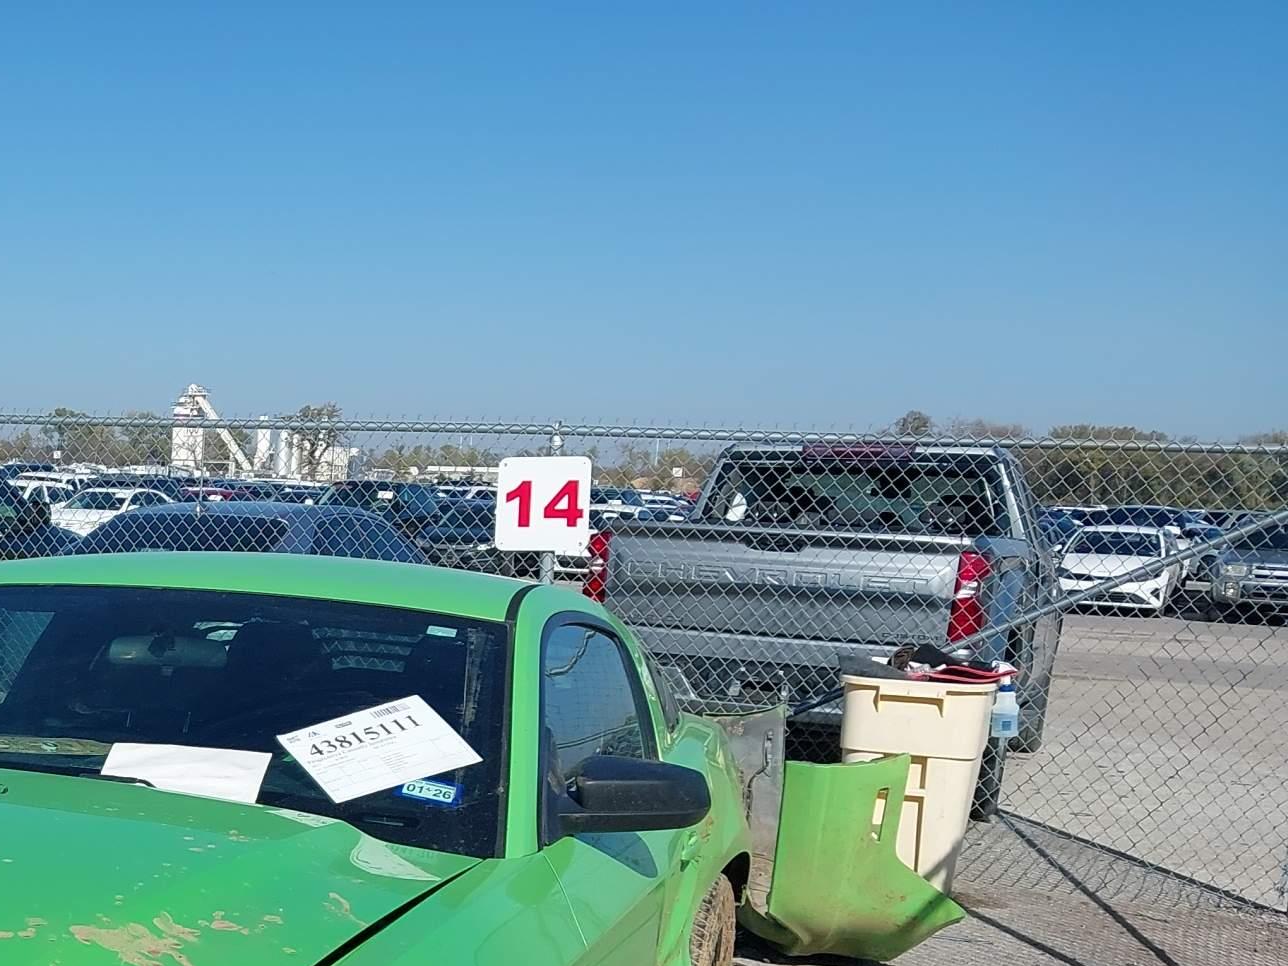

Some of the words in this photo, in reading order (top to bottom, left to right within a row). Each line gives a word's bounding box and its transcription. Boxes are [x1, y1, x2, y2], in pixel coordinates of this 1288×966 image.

[506, 480, 584, 527] 14
[626, 560, 930, 594] CHEVROLET
[310, 714, 423, 758] 43815111
